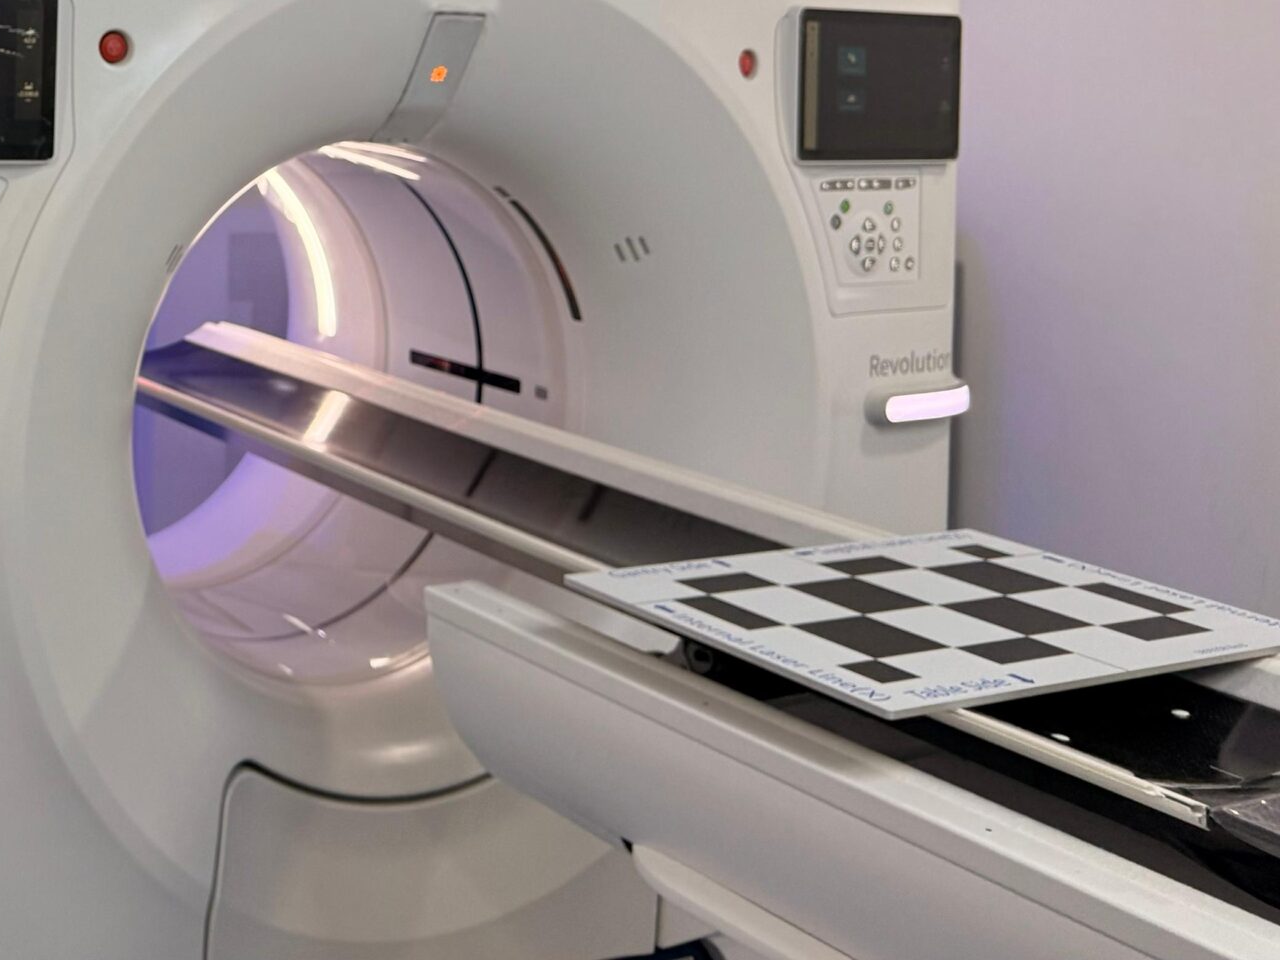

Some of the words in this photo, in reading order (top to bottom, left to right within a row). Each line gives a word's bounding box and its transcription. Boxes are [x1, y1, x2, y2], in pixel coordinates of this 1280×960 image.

[749, 644, 809, 669] Laser
[903, 685, 963, 701] Table
[962, 676, 1012, 692] Side
